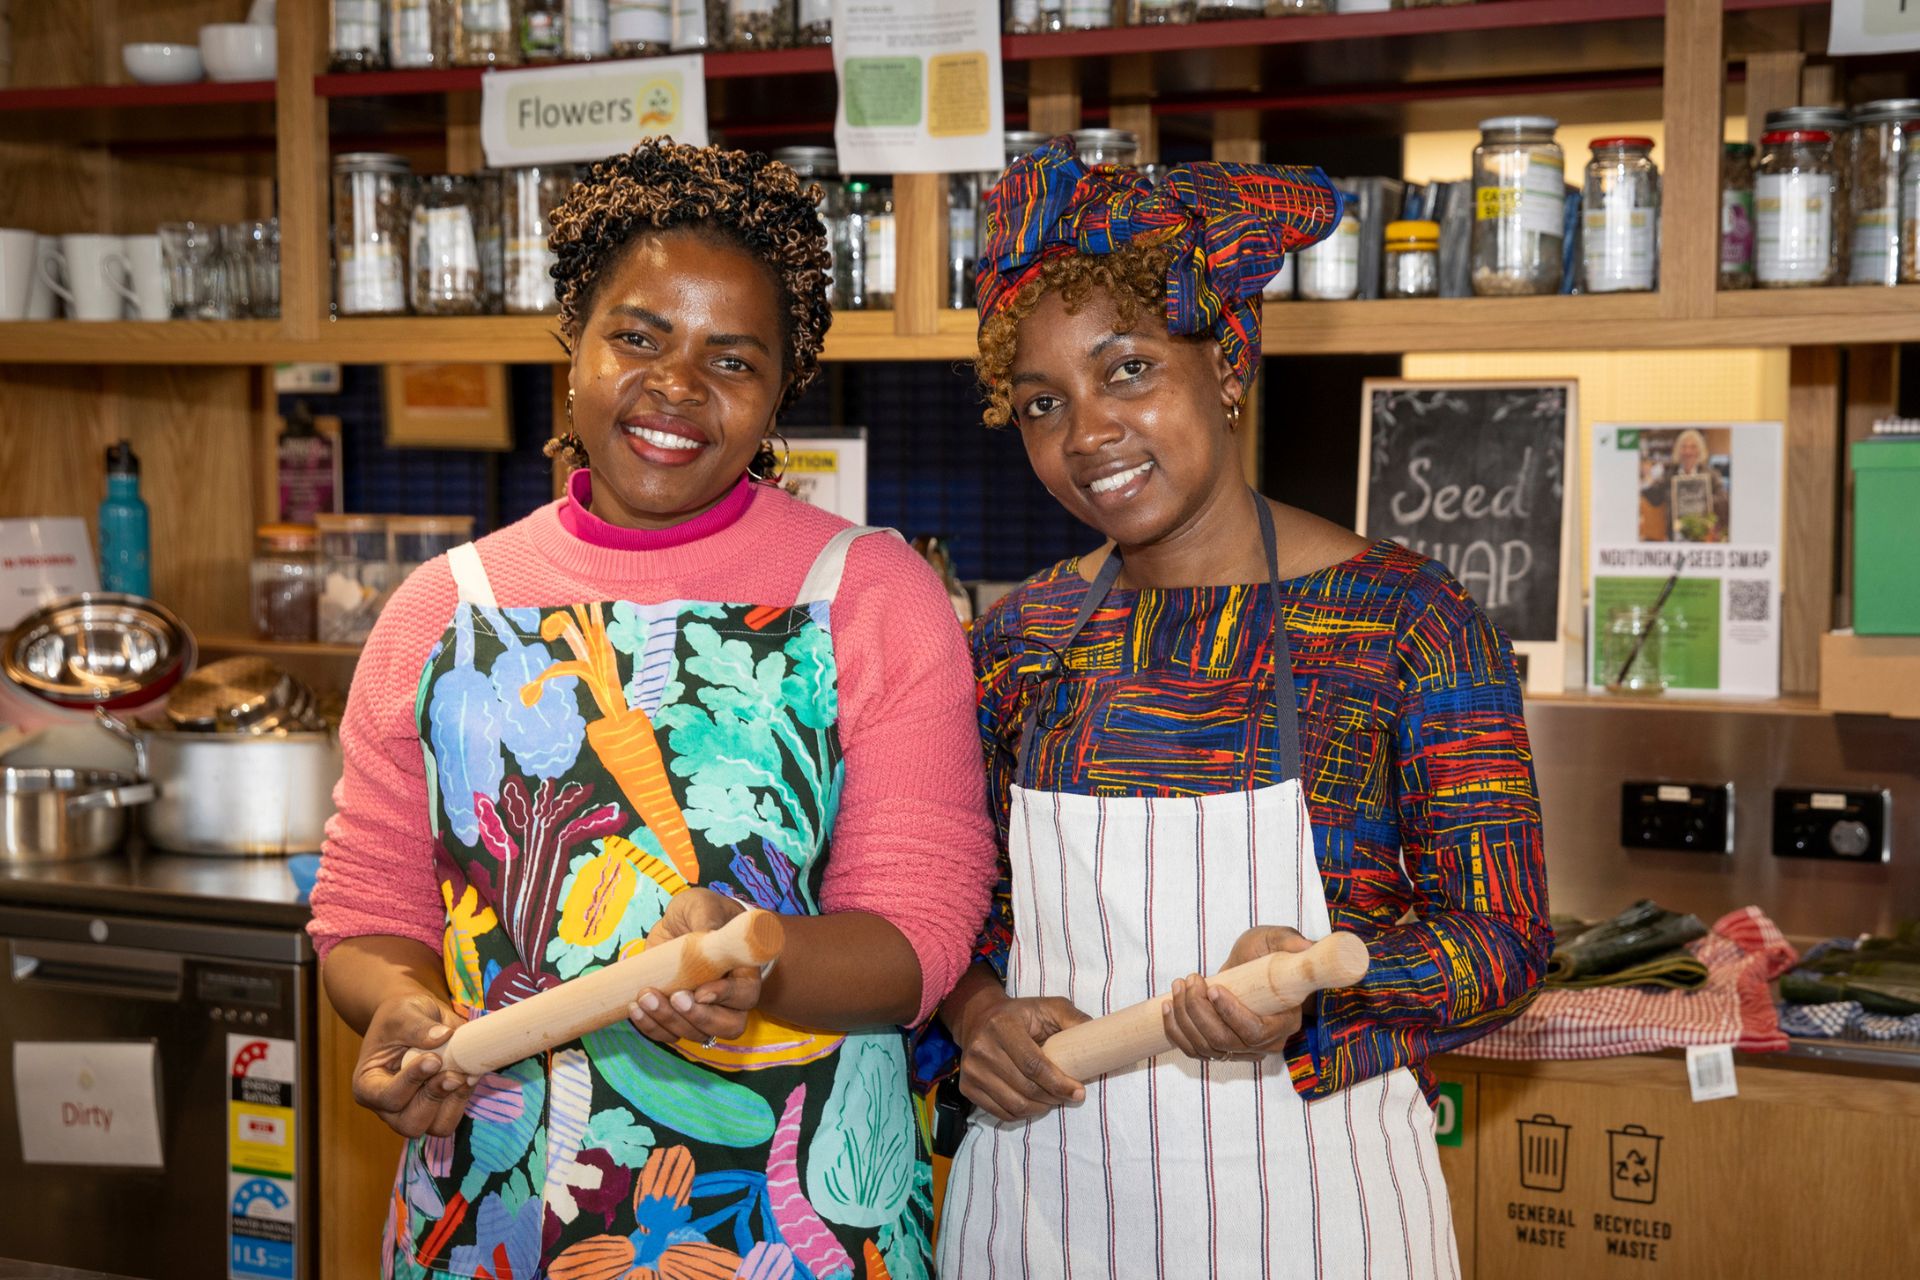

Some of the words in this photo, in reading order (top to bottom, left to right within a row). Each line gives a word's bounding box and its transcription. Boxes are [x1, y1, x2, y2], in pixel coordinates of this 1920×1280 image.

[519, 96, 632, 130] Flowers
[1390, 446, 1532, 525] Seed
[1689, 550, 1724, 569] SEED
[1728, 551, 1770, 570] SWAP
[62, 1102, 113, 1133] Dirty
[1507, 1202, 1576, 1228] GENERAL
[1594, 1213, 1672, 1240] RECYCLED
[1516, 1226, 1566, 1249] WASTE
[1607, 1238, 1658, 1262] WASTE
